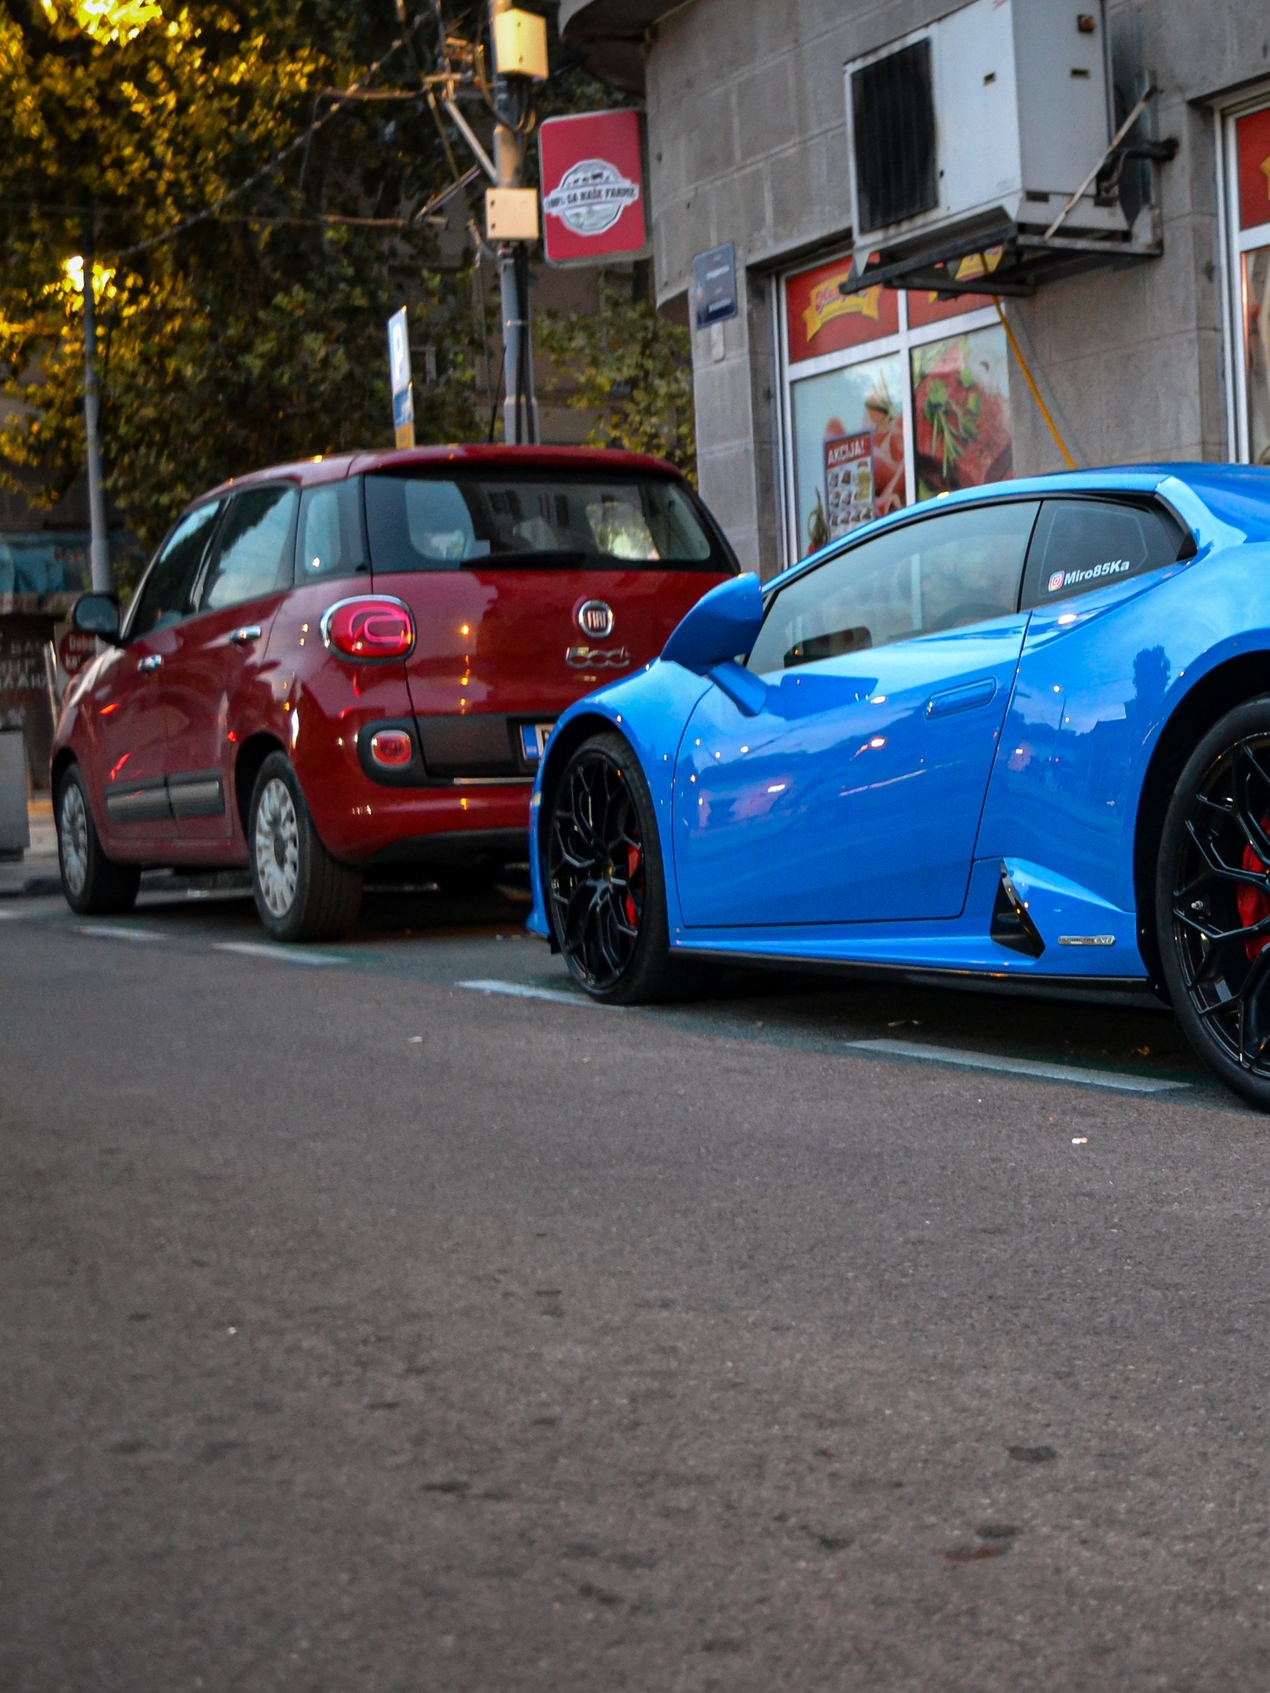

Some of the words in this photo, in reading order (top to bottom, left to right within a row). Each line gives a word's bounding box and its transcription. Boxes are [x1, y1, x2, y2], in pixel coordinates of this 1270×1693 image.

[827, 439, 866, 464] AKCIJA!
[1064, 559, 1130, 586] Miro85Ka
[587, 610, 607, 629] FIAT
